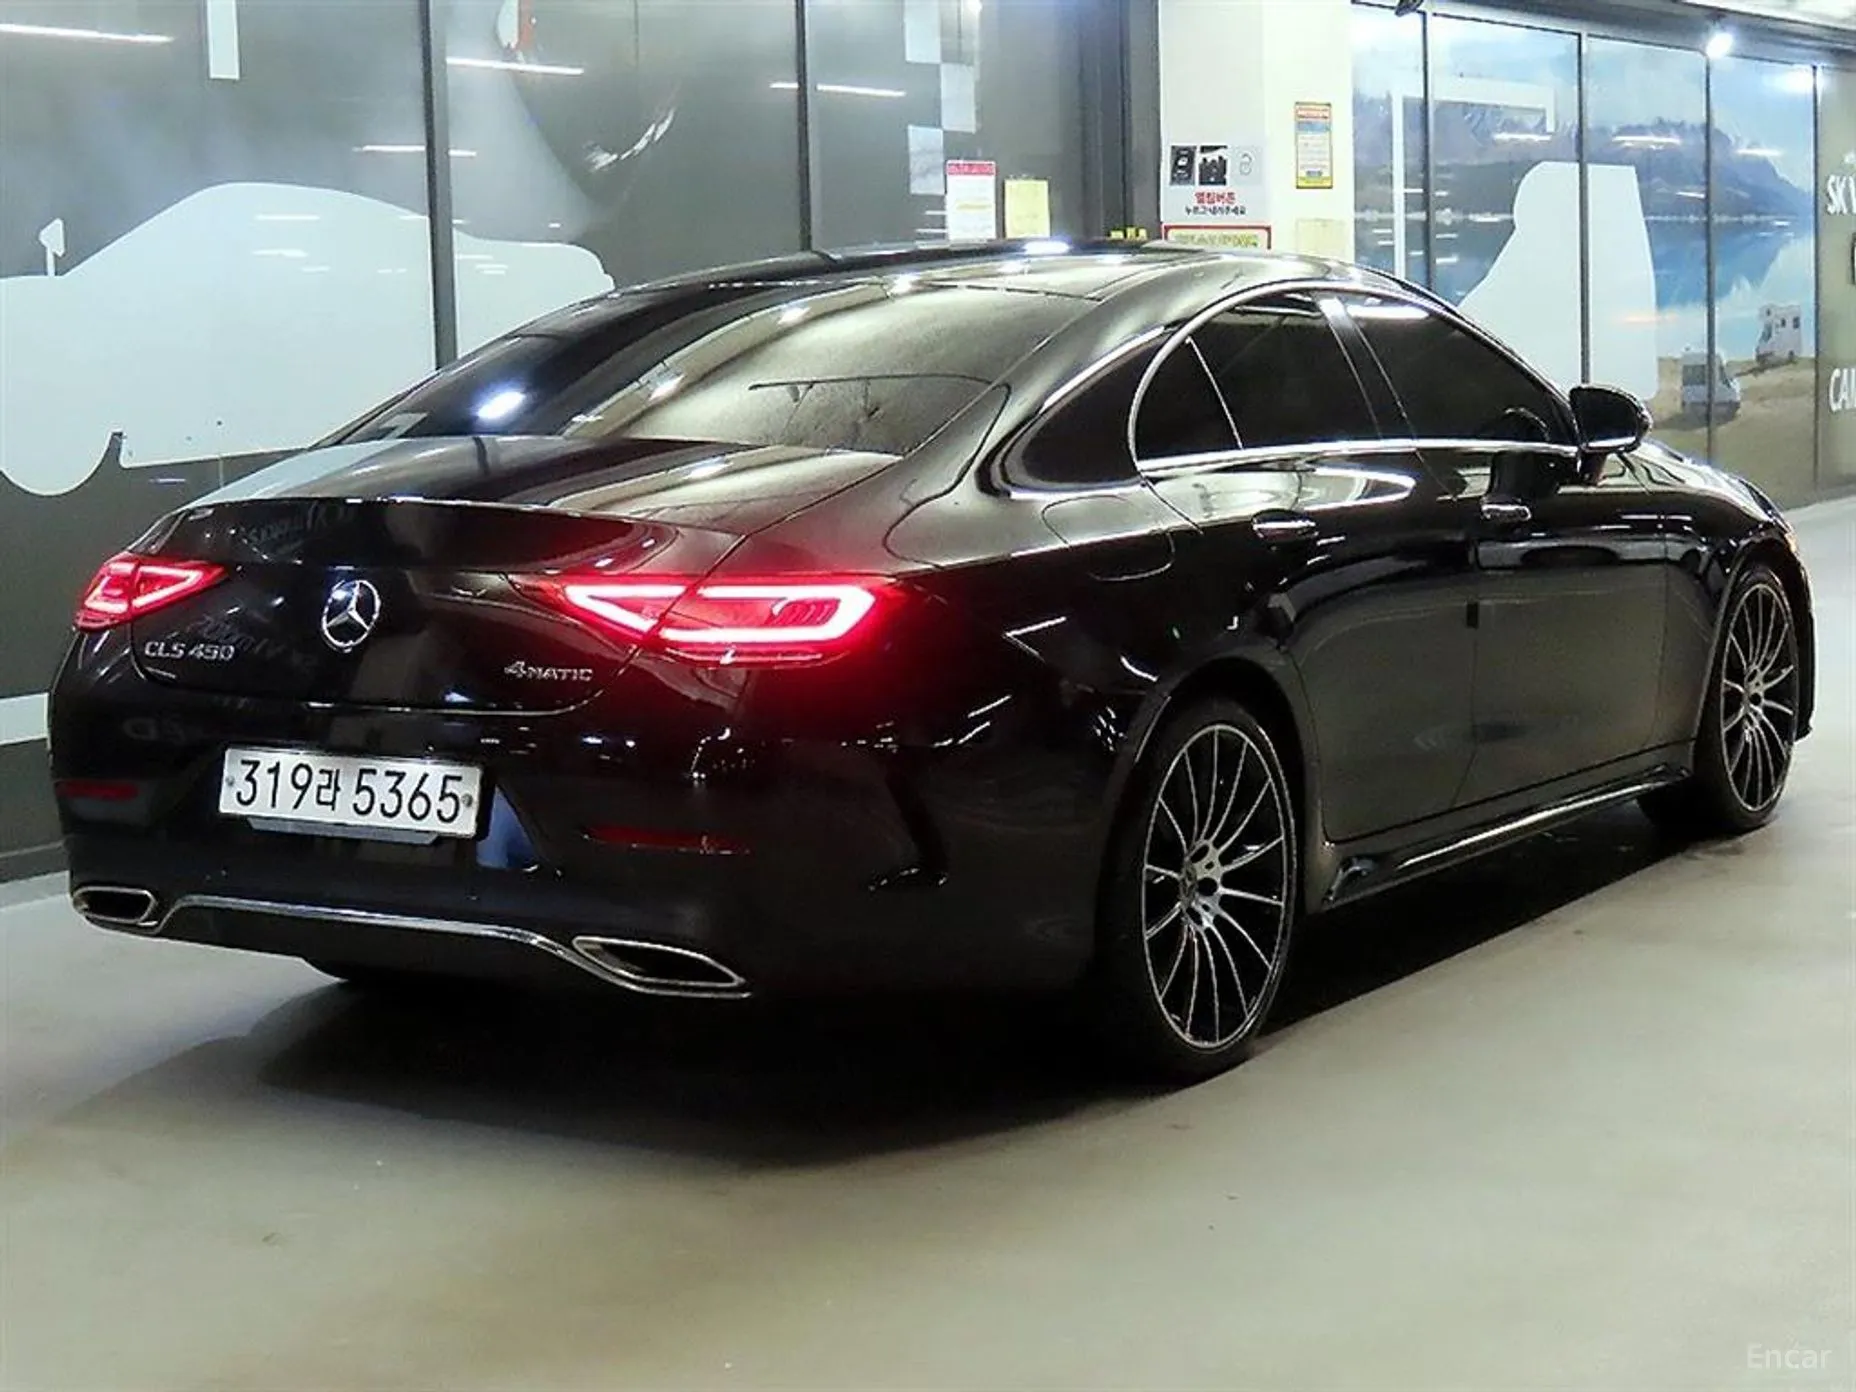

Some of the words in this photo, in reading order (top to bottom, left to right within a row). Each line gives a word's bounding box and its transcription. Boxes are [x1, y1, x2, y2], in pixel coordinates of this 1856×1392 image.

[1827, 175, 1848, 214] SK
[144, 641, 187, 659] CLS
[188, 643, 235, 661] 450
[504, 661, 593, 681] 4MATIC
[235, 759, 341, 811] 319라
[352, 768, 463, 824] 5365
